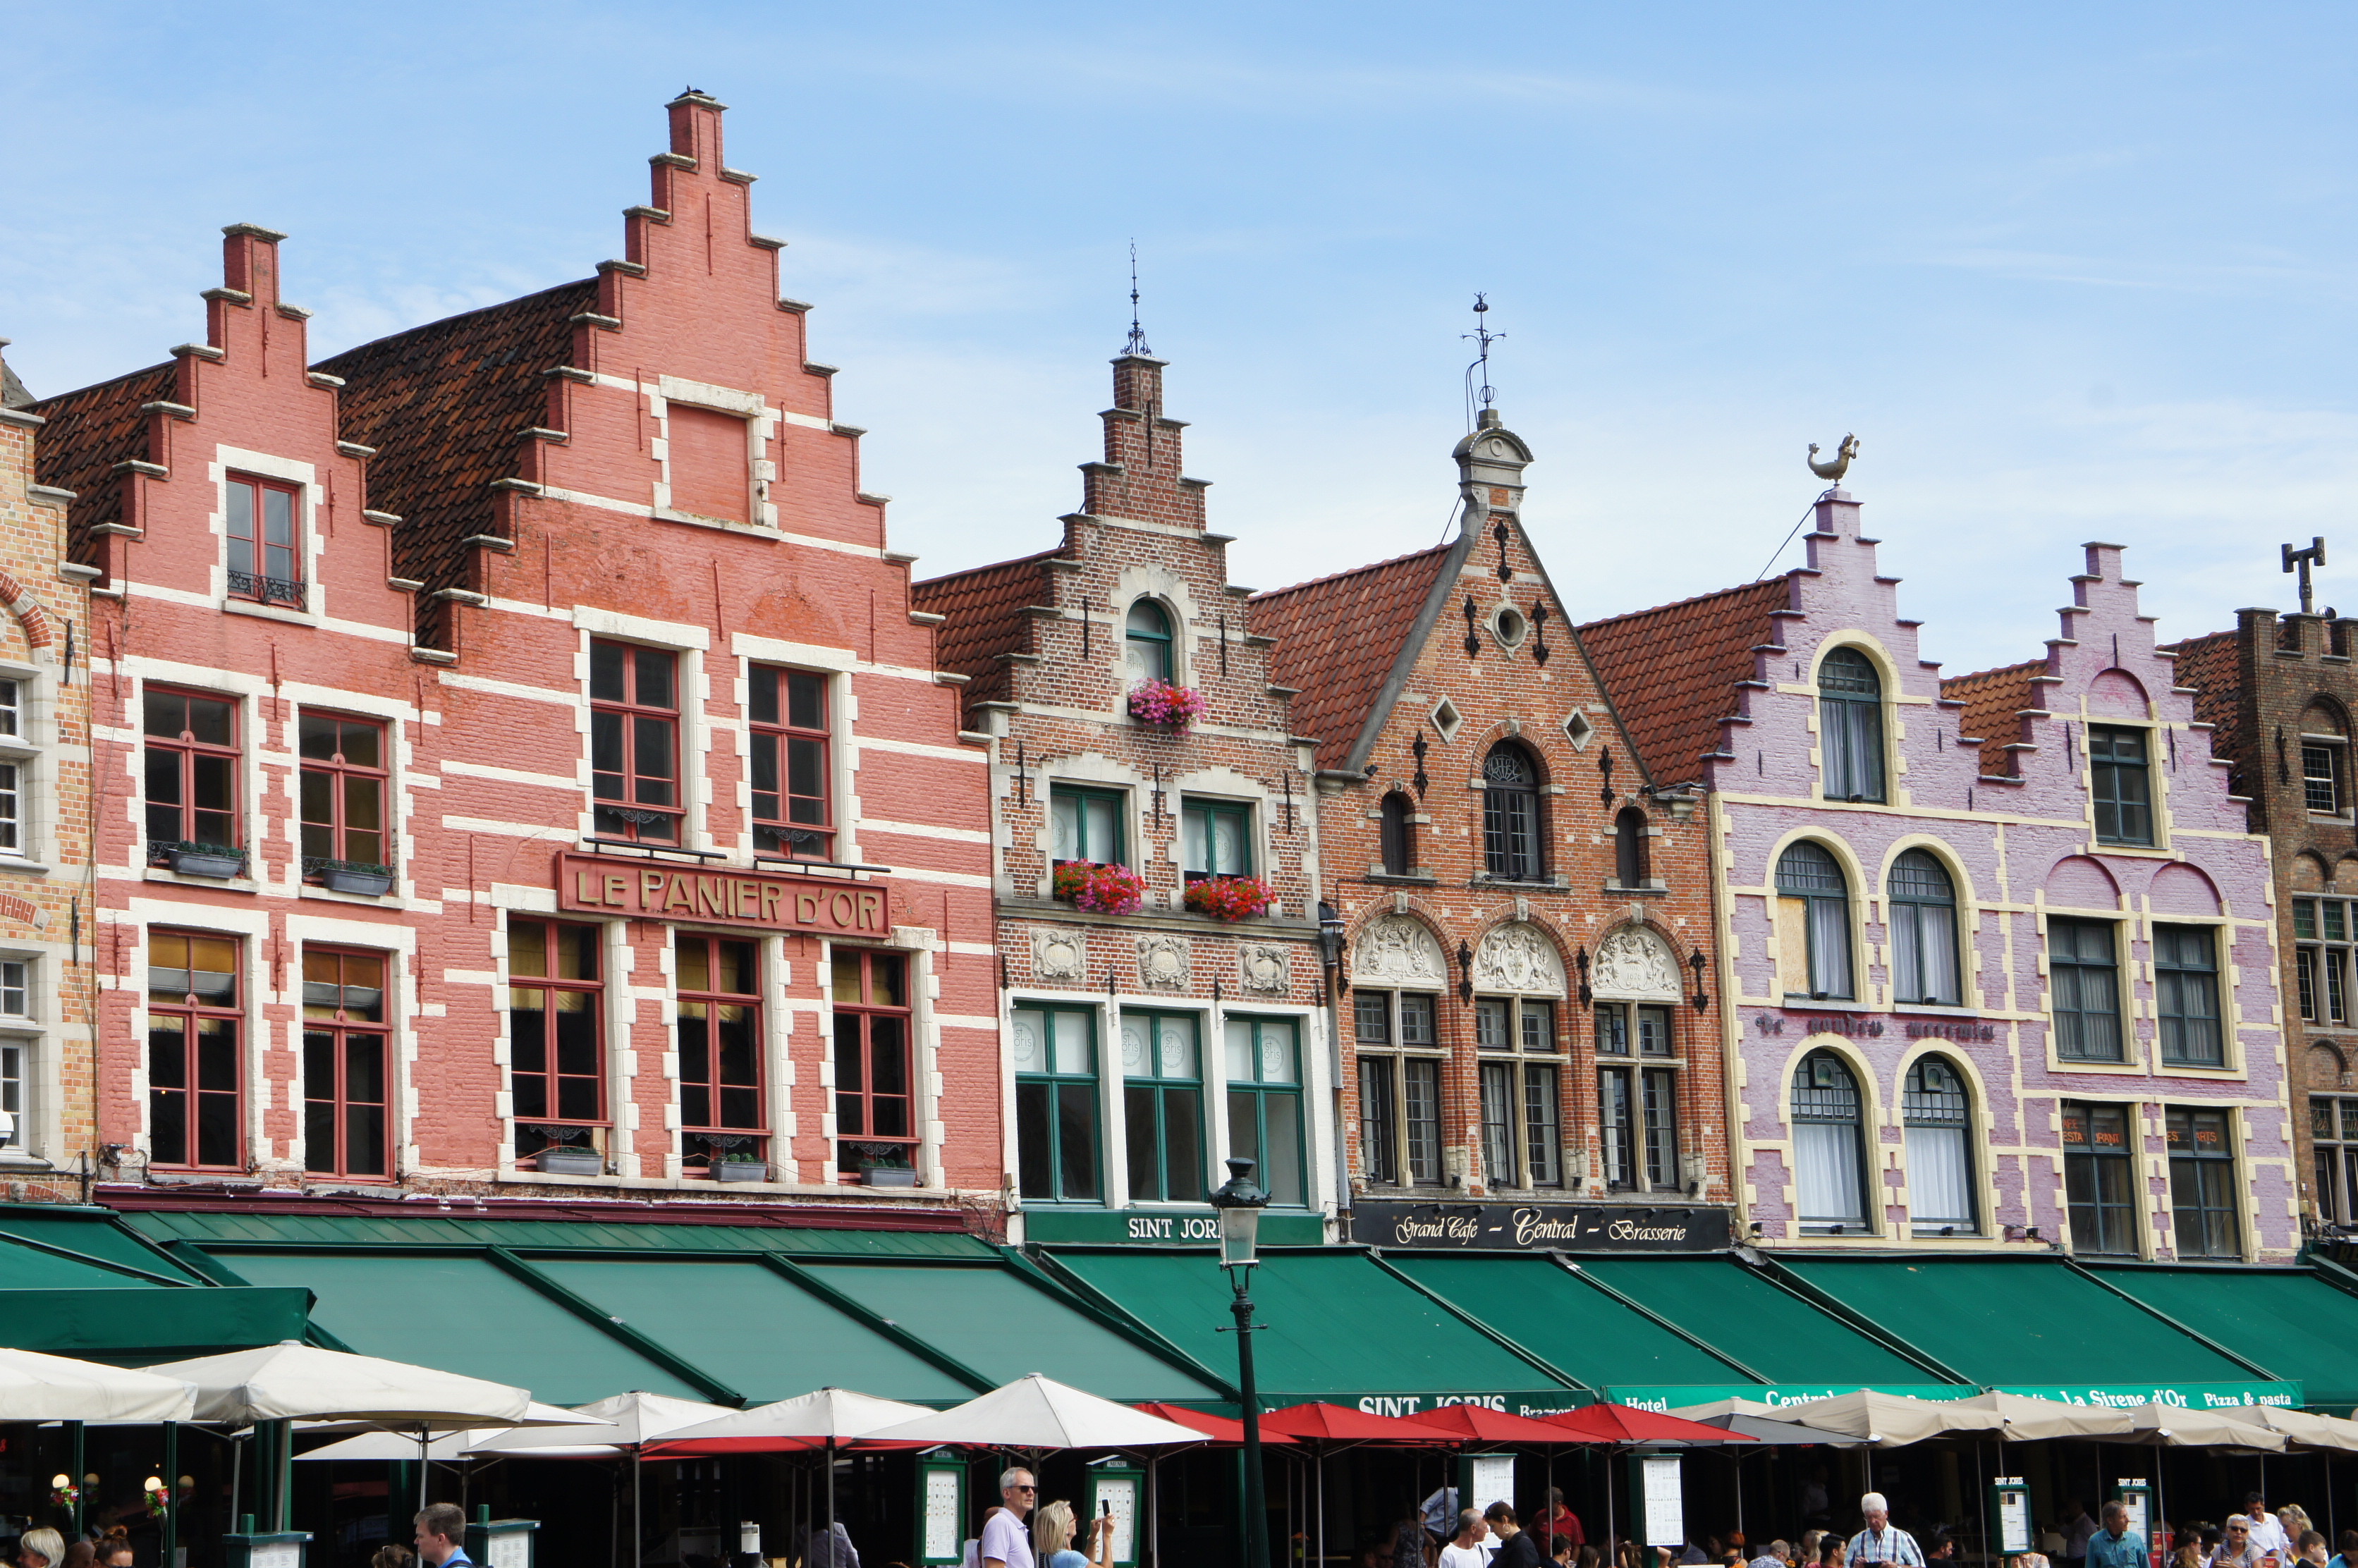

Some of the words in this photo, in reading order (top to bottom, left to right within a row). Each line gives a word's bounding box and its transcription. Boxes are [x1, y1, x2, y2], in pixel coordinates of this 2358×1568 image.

[1126, 661, 1143, 671] oris
[578, 871, 628, 905] LE
[639, 869, 783, 920] PANIER
[796, 888, 880, 929] D'OR
[2063, 1119, 2079, 1129] AFE
[1128, 1218, 1173, 1238] SINT
[1180, 1218, 1221, 1239] JORI
[1395, 1215, 1444, 1244] Grand
[1446, 1216, 1478, 1245] Cafe
[1513, 1207, 1578, 1246] Central
[1608, 1220, 1686, 1242] Brasserie
[1625, 1397, 1668, 1413] Hotel
[2060, 1391, 2087, 1407] La
[2089, 1390, 2148, 1407] Sirene
[2152, 1390, 2187, 1407] d'Or
[2203, 1392, 2240, 1407] Pizza
[2243, 1391, 2254, 1406] &
[1358, 1396, 1421, 1419] SINT
[1994, 1477, 2008, 1486] SINT
[2008, 1476, 2024, 1485] JORIS
[2118, 1478, 2131, 1486] SINT
[2131, 1478, 2146, 1486] JORIS
